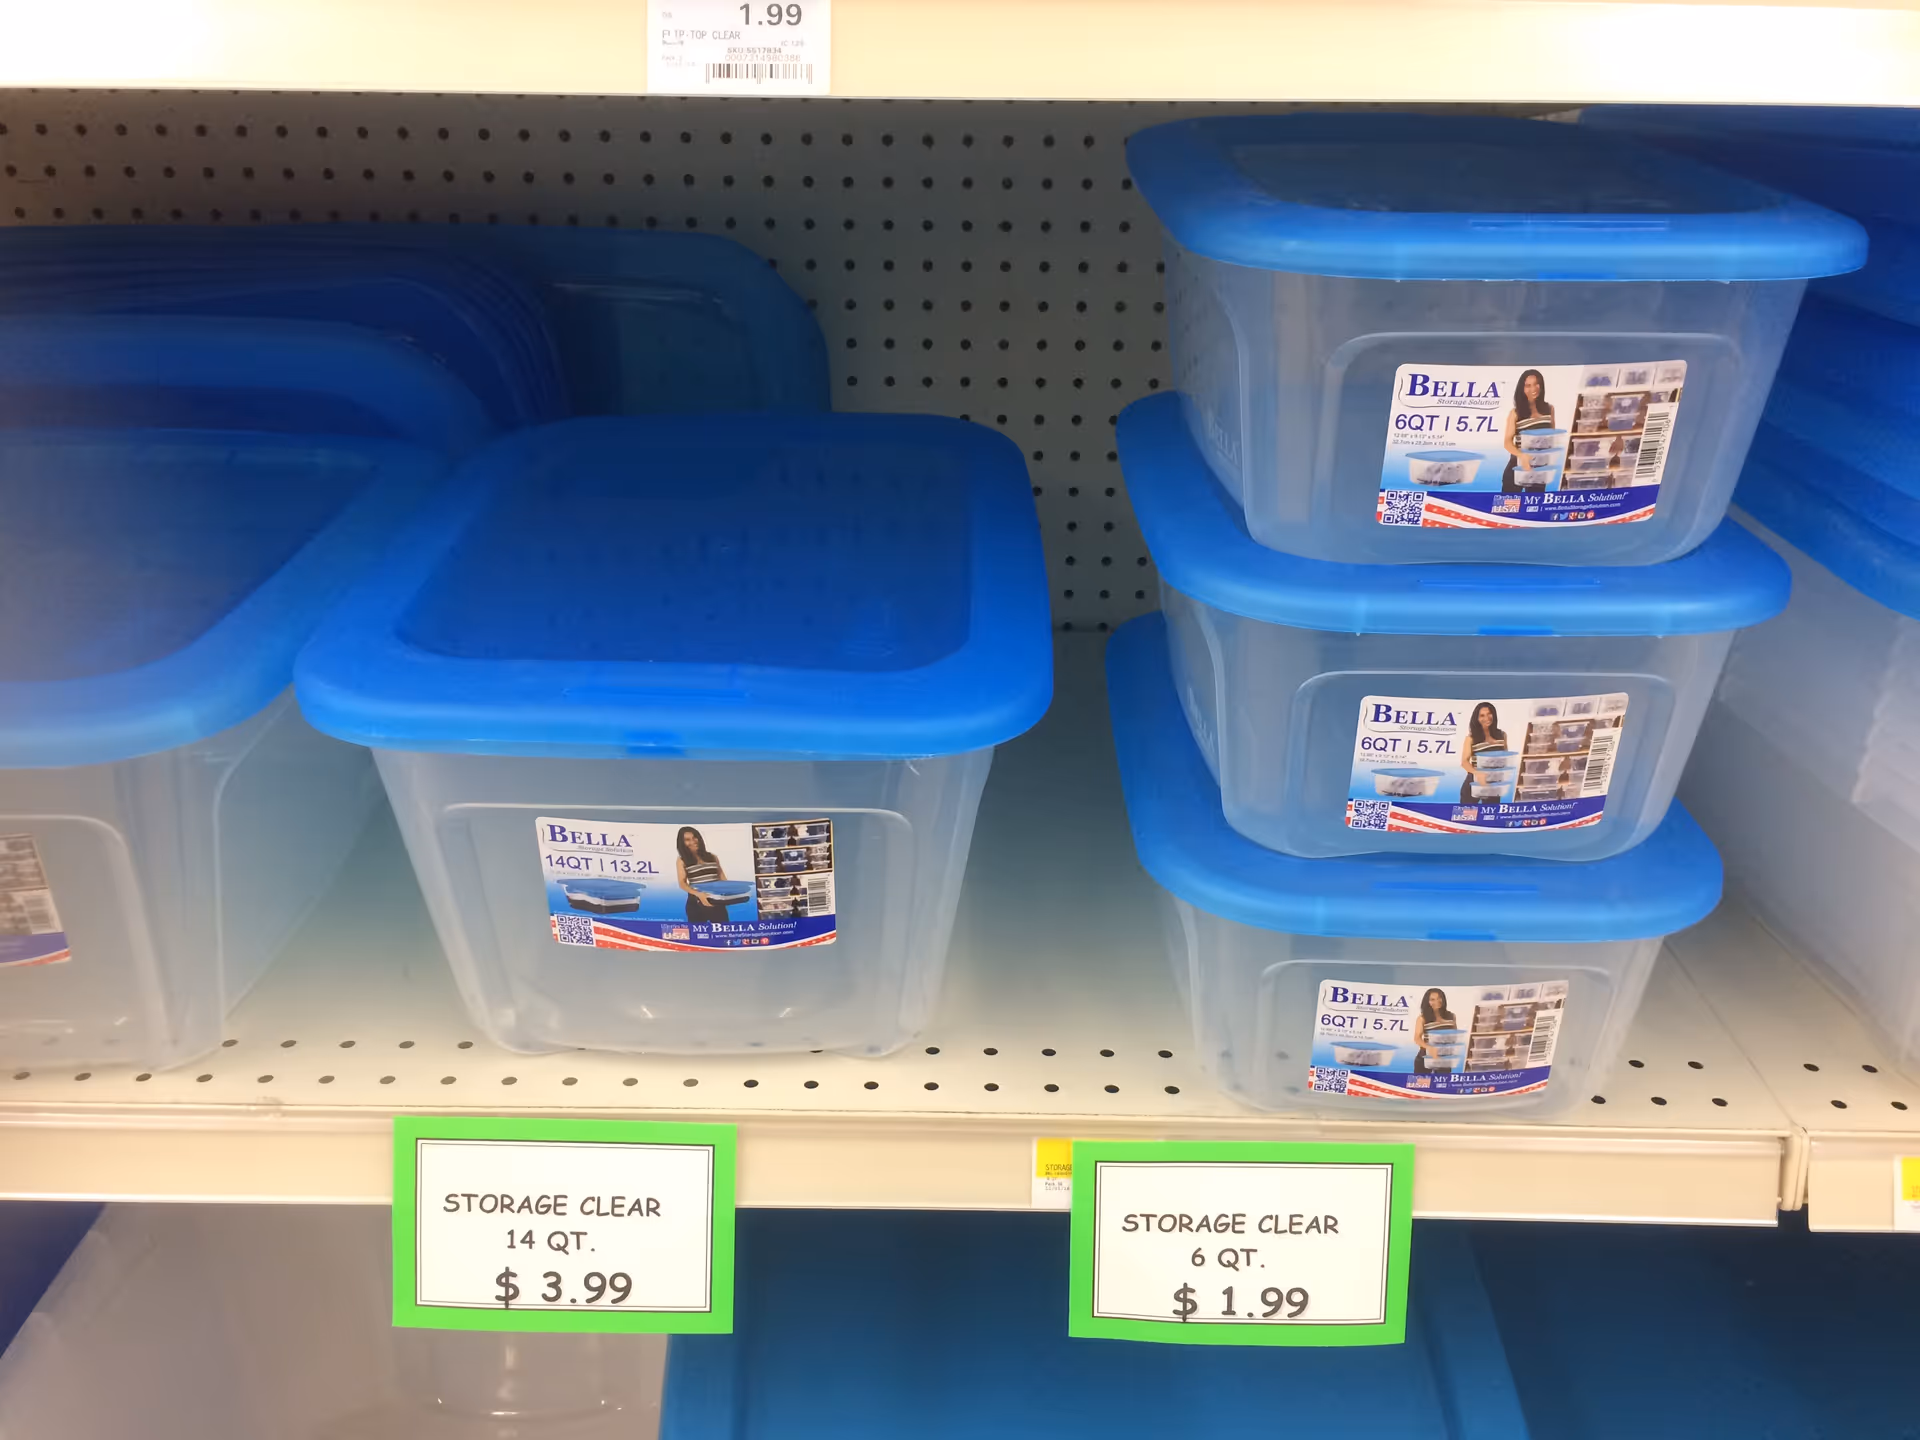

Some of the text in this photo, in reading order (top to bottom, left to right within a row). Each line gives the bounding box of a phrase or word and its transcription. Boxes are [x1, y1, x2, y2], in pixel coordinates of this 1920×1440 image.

[739, 2, 803, 26] 1.99
[712, 30, 741, 40] CLEAR
[1405, 373, 1501, 398] BELLA
[1436, 398, 1500, 406] Storage Solution
[1395, 413, 1440, 431] 6QT
[1456, 415, 1499, 433] 5.7L
[1524, 492, 1626, 505] MY BELLA Solution!
[1370, 703, 1457, 726] BELLA
[1361, 736, 1401, 752] 6QT
[1417, 740, 1456, 754] 5.7L
[1481, 806, 1496, 814] MY
[1498, 804, 1537, 814] BELLA
[1540, 802, 1576, 811] Solution!
[547, 823, 633, 847] BELLA
[545, 854, 593, 870] 14QT
[610, 859, 660, 874] 13.2L
[692, 924, 709, 932] MY
[711, 922, 755, 932] BELLA
[758, 922, 797, 931] Solution!
[1329, 986, 1409, 1008] BELLA
[1321, 1014, 1358, 1028] 6QT
[1372, 1018, 1409, 1032] 5.7L
[1450, 1074, 1486, 1083] BELLA
[1488, 1072, 1522, 1081] Solution!
[443, 1193, 662, 1218] STORAGE CLEAR
[1121, 1212, 1340, 1235] STORAGE CLEAR
[506, 1229, 596, 1255] 14 QT.
[1190, 1246, 1266, 1272] 6 QT.
[494, 1266, 633, 1309] $ 3.99
[1172, 1282, 1310, 1323] $ 1.99
